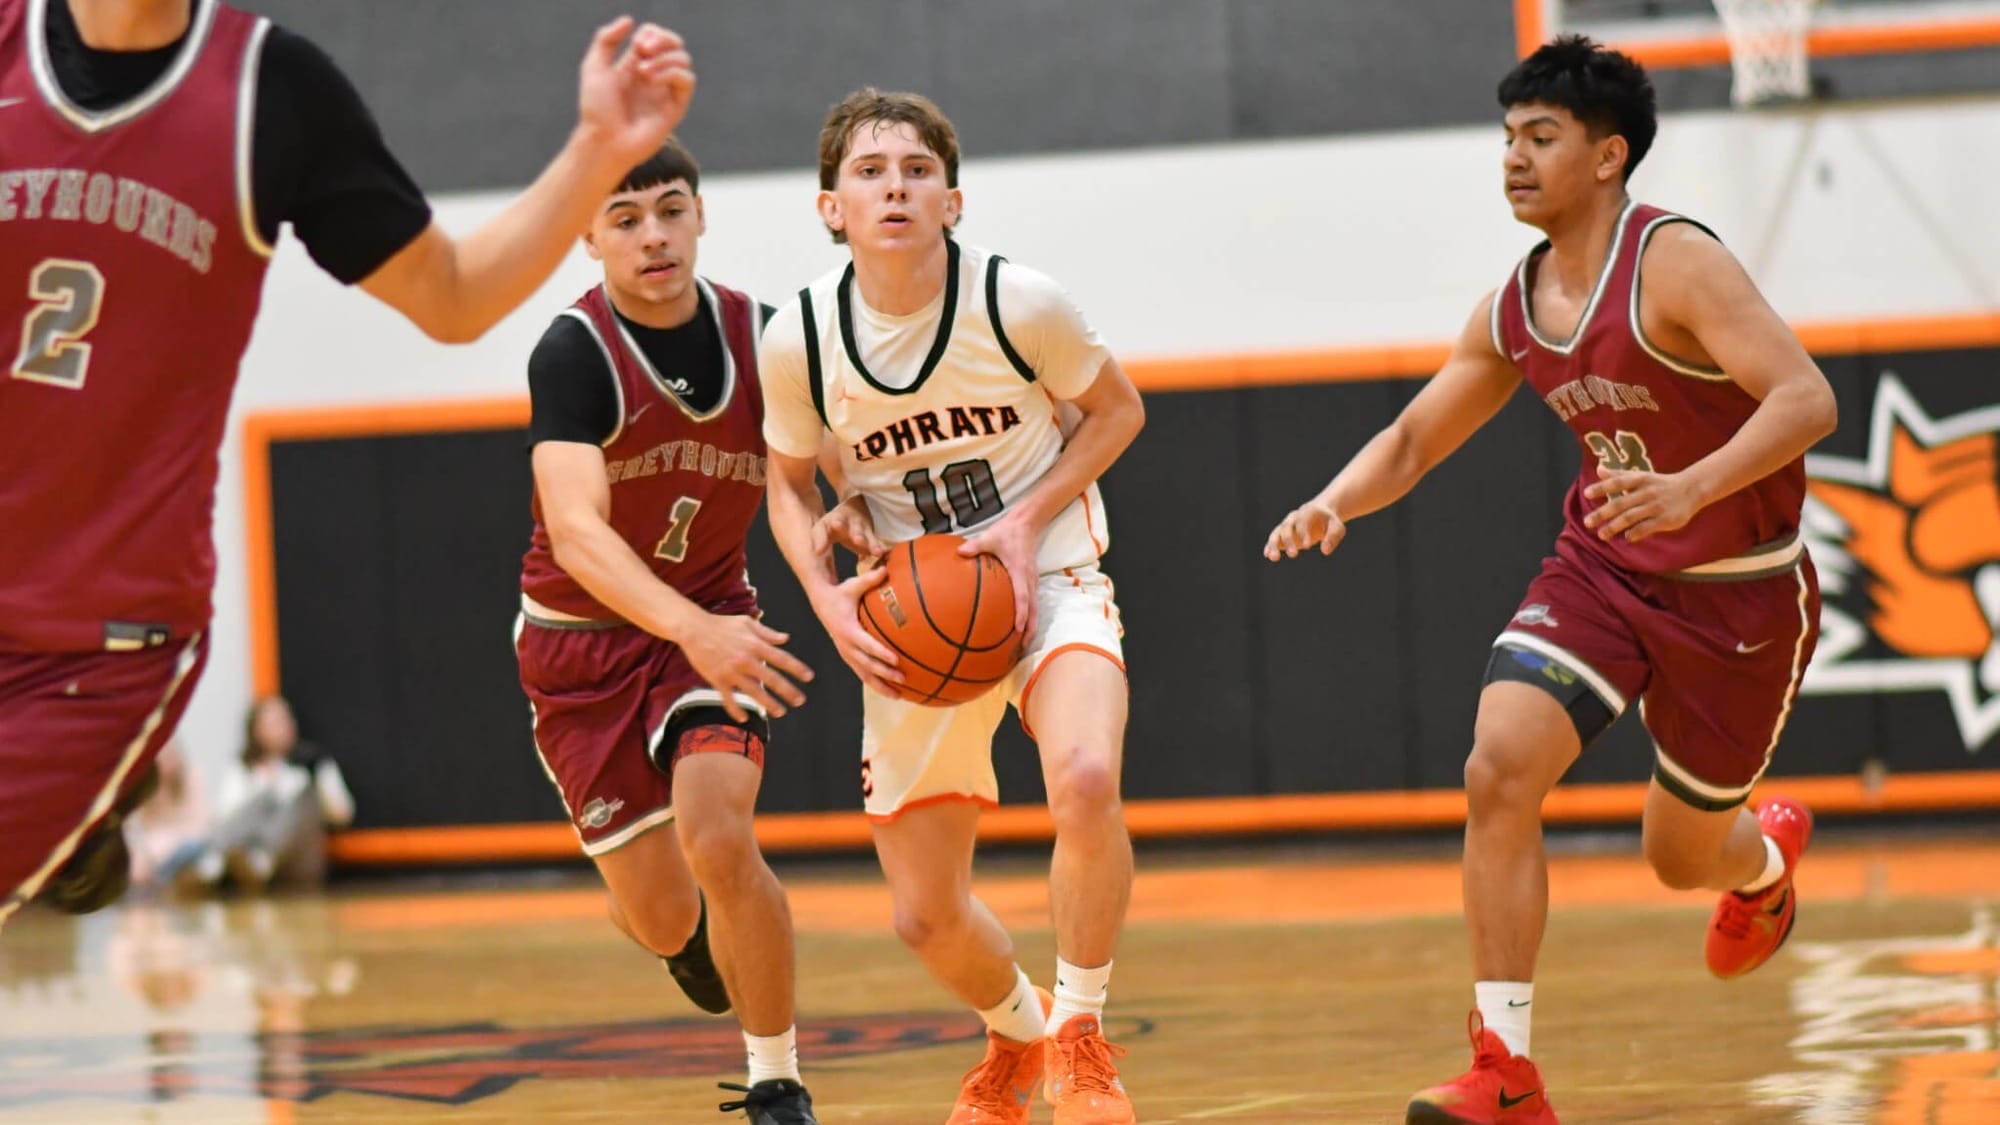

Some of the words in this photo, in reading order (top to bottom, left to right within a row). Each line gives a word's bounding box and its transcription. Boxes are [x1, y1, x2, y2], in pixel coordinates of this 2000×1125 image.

[11, 257, 106, 390] 2
[653, 495, 703, 563] 1
[902, 457, 1005, 534] 10
